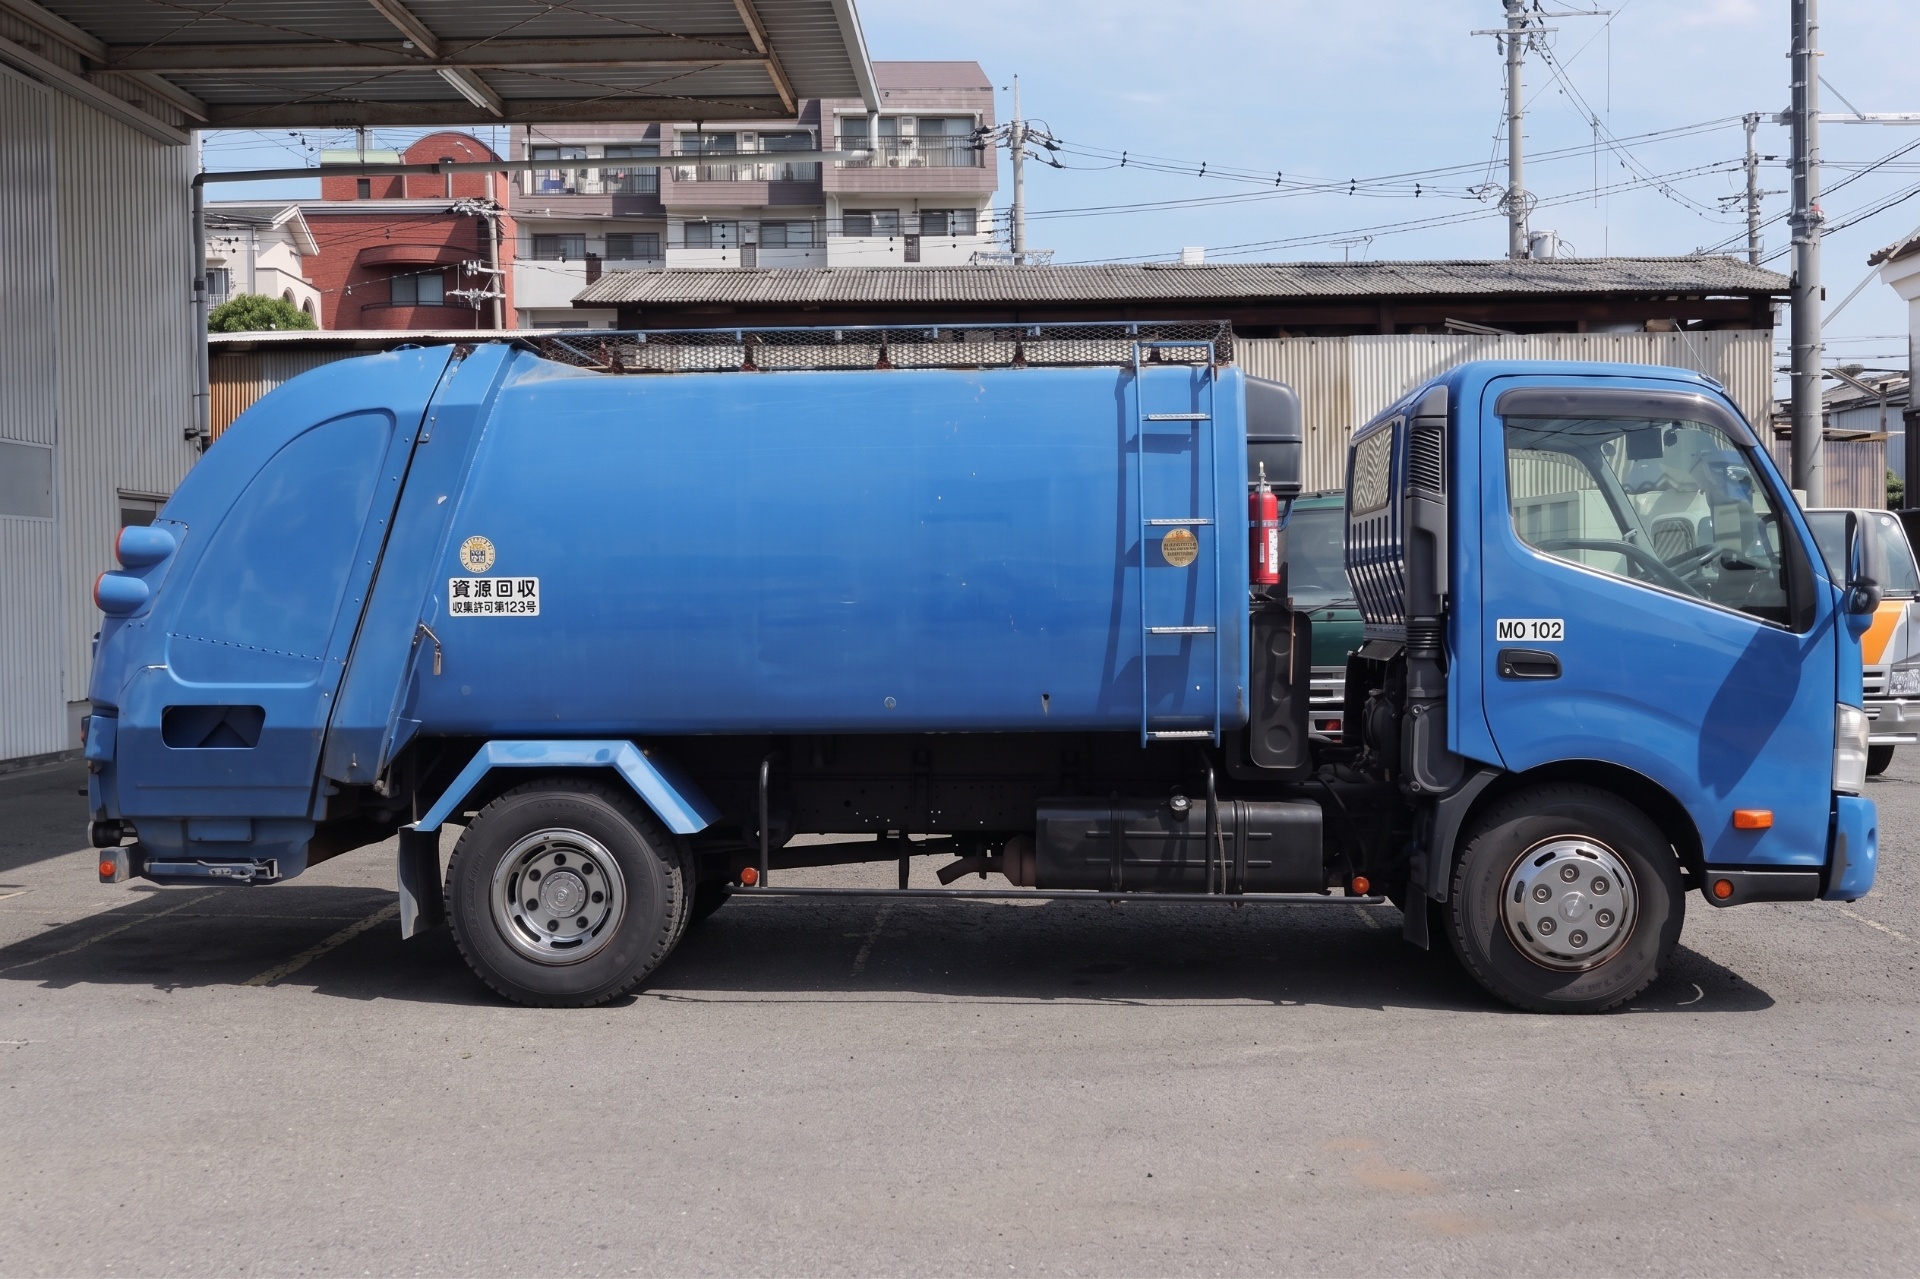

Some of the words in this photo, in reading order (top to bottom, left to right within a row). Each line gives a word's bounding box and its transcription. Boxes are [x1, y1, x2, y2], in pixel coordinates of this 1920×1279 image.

[452, 579, 536, 598] 資源回収
[452, 600, 537, 614] 収集許可第123号
[1499, 621, 1526, 639] MO
[1530, 621, 1562, 639] 102
